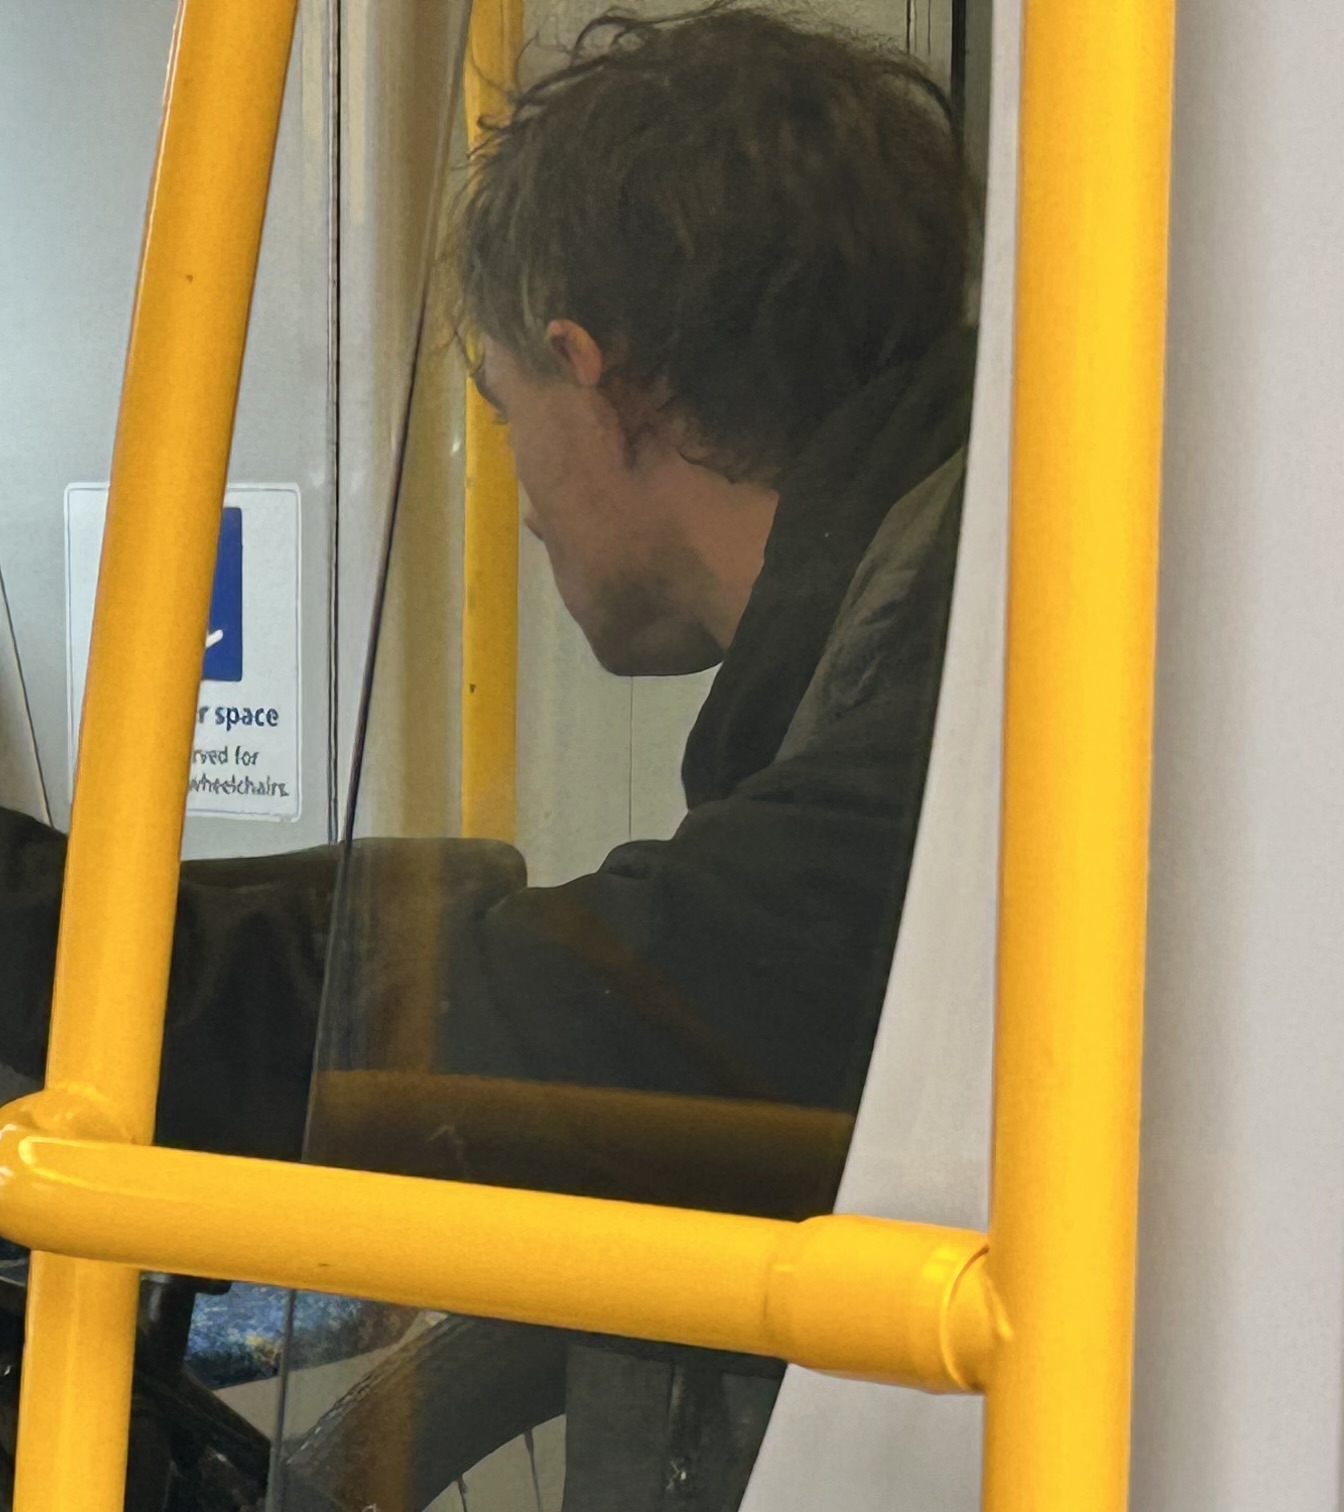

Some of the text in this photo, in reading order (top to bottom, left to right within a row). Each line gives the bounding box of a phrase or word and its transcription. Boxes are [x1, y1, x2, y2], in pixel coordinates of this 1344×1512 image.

[214, 705, 280, 732] space
[192, 744, 260, 766] rved for
